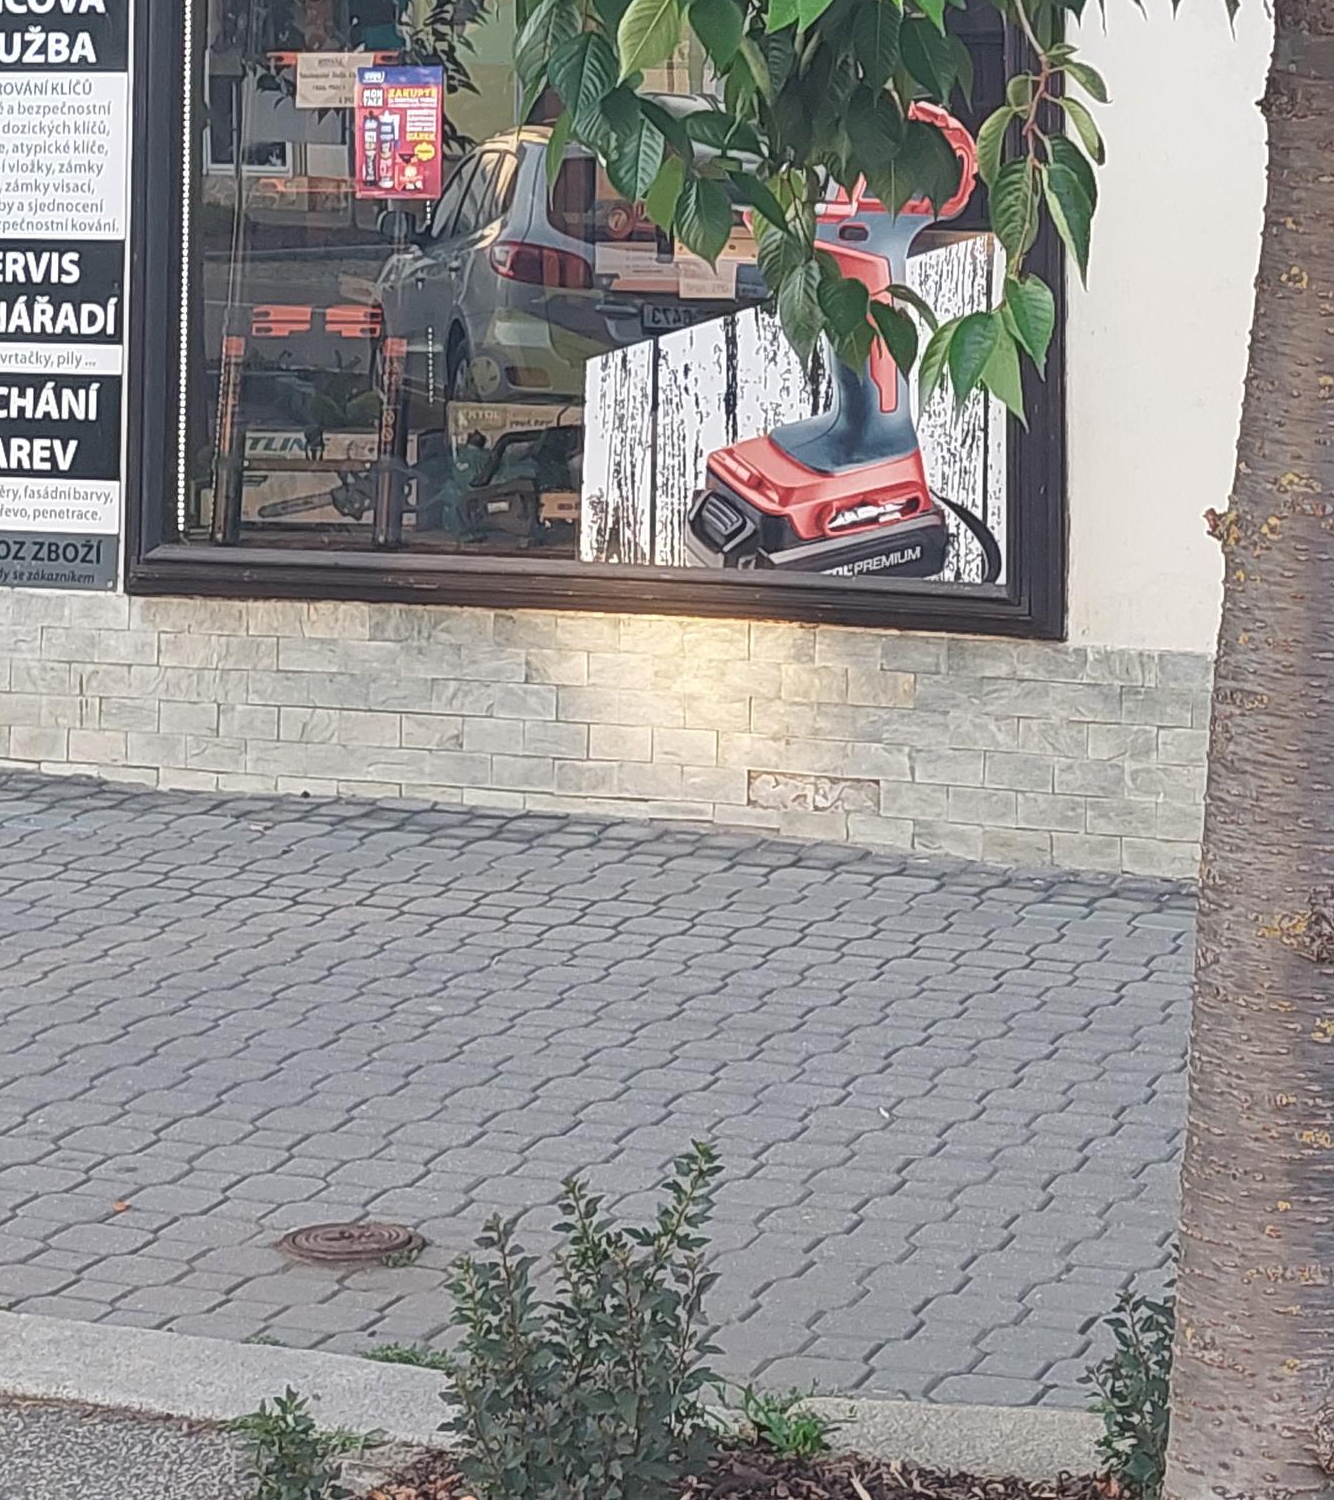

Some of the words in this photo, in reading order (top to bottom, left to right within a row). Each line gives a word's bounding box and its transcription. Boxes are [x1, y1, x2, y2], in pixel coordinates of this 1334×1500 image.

[51, 79, 92, 95] KLÍČŮ
[7, 105, 14, 114] a
[17, 101, 112, 118] bezpečnostní
[2, 121, 70, 137] dozických
[74, 122, 110, 136] klíčů,
[12, 140, 70, 156] atypické
[74, 141, 108, 156] klíče,
[8, 160, 55, 175] vložky,
[58, 160, 104, 177] zámky
[5, 178, 50, 195] zámky
[53, 179, 94, 194] visací,
[17, 202, 24, 212] a
[28, 199, 104, 215] sjednocení
[0, 351, 53, 366] vrtačky,
[57, 352, 82, 368] pily
[24, 485, 71, 499] fasádní
[73, 488, 113, 504] barvy,
[31, 539, 103, 565] ZBOŽÍ
[854, 546, 921, 575] PREMIUM
[13, 572, 25, 580] se
[27, 571, 94, 583] zákazníkem
